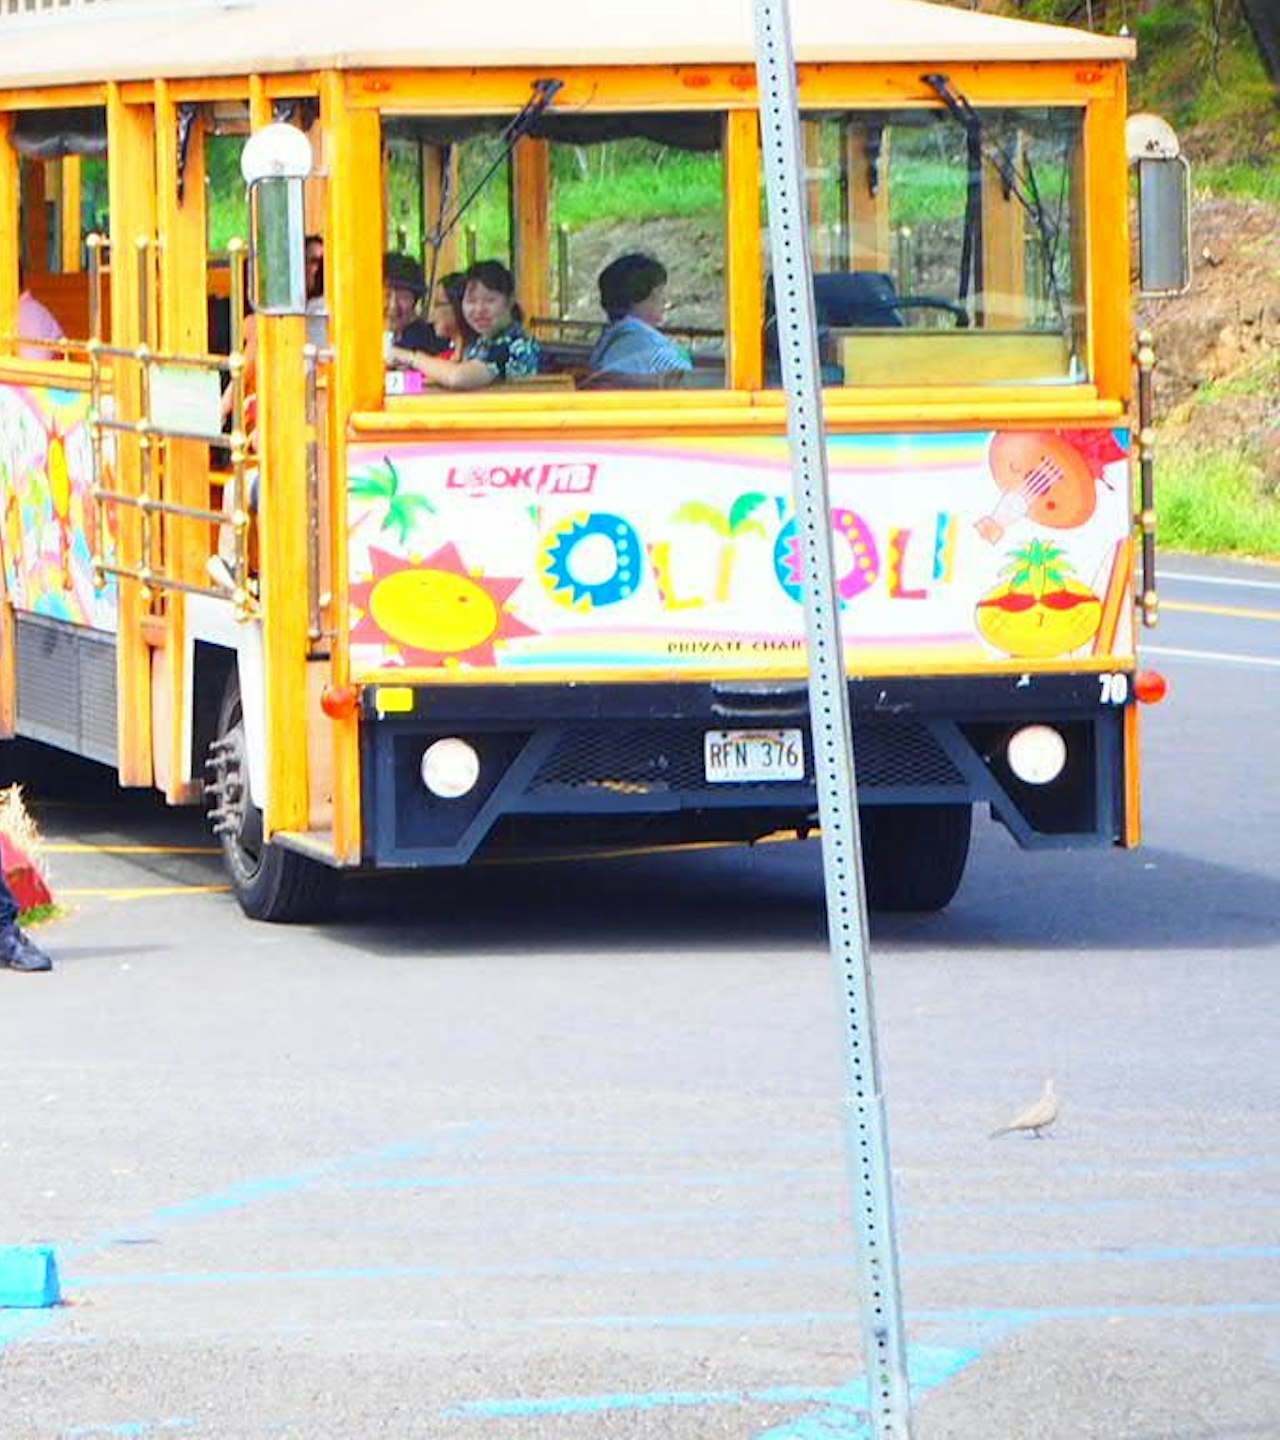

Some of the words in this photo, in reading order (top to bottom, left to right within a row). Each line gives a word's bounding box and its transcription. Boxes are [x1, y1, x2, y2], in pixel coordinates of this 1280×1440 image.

[667, 641, 741, 653] PRIVATE
[1098, 673, 1128, 704] 70
[710, 741, 747, 767] RFN
[761, 741, 798, 767] 376
